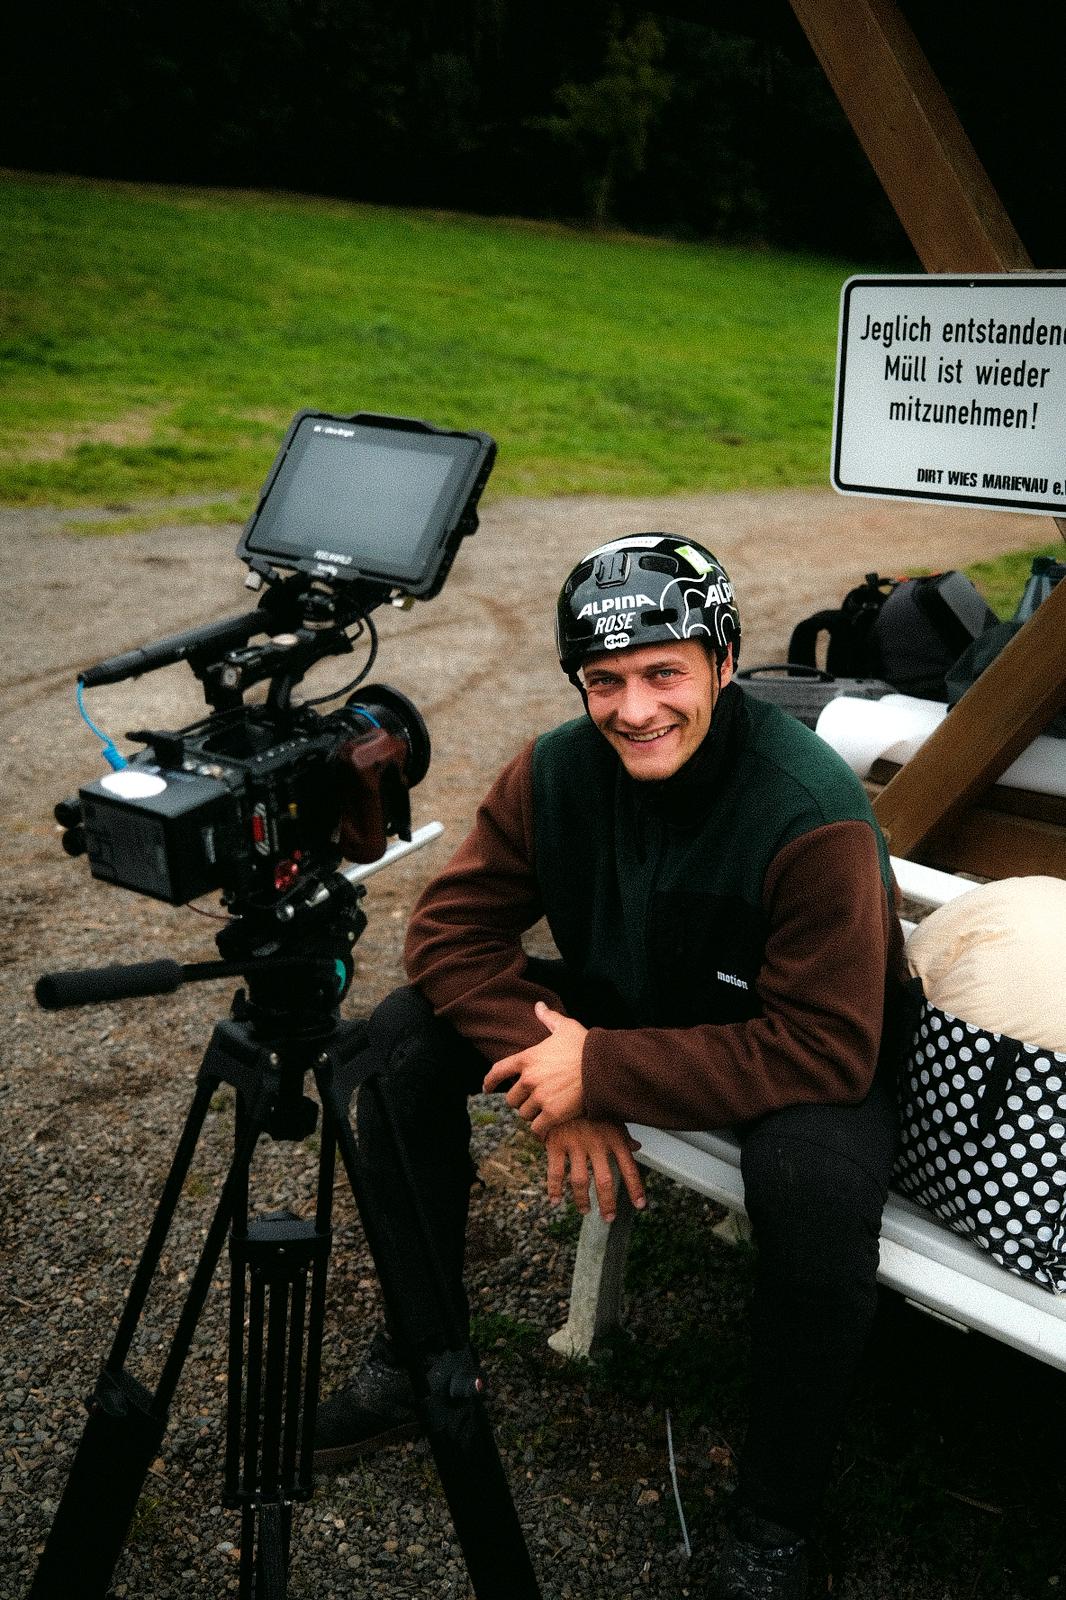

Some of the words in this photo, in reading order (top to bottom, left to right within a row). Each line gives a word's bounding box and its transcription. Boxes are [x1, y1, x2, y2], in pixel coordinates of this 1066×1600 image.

[860, 314, 931, 348] Jeglich
[942, 317, 1066, 346] entstanden
[884, 355, 926, 383] Müll
[937, 356, 963, 384] ist
[976, 358, 1050, 388] wieder
[889, 396, 1038, 430] mitzunehmen!
[917, 468, 944, 484] DIRT
[948, 470, 978, 488] WIES
[982, 473, 1048, 494] MARIENAU
[1053, 480, 1066, 495] e.
[576, 594, 657, 620] ALPINA
[594, 612, 636, 635] ROSE
[606, 637, 628, 646] KMC
[717, 971, 748, 990] motion
